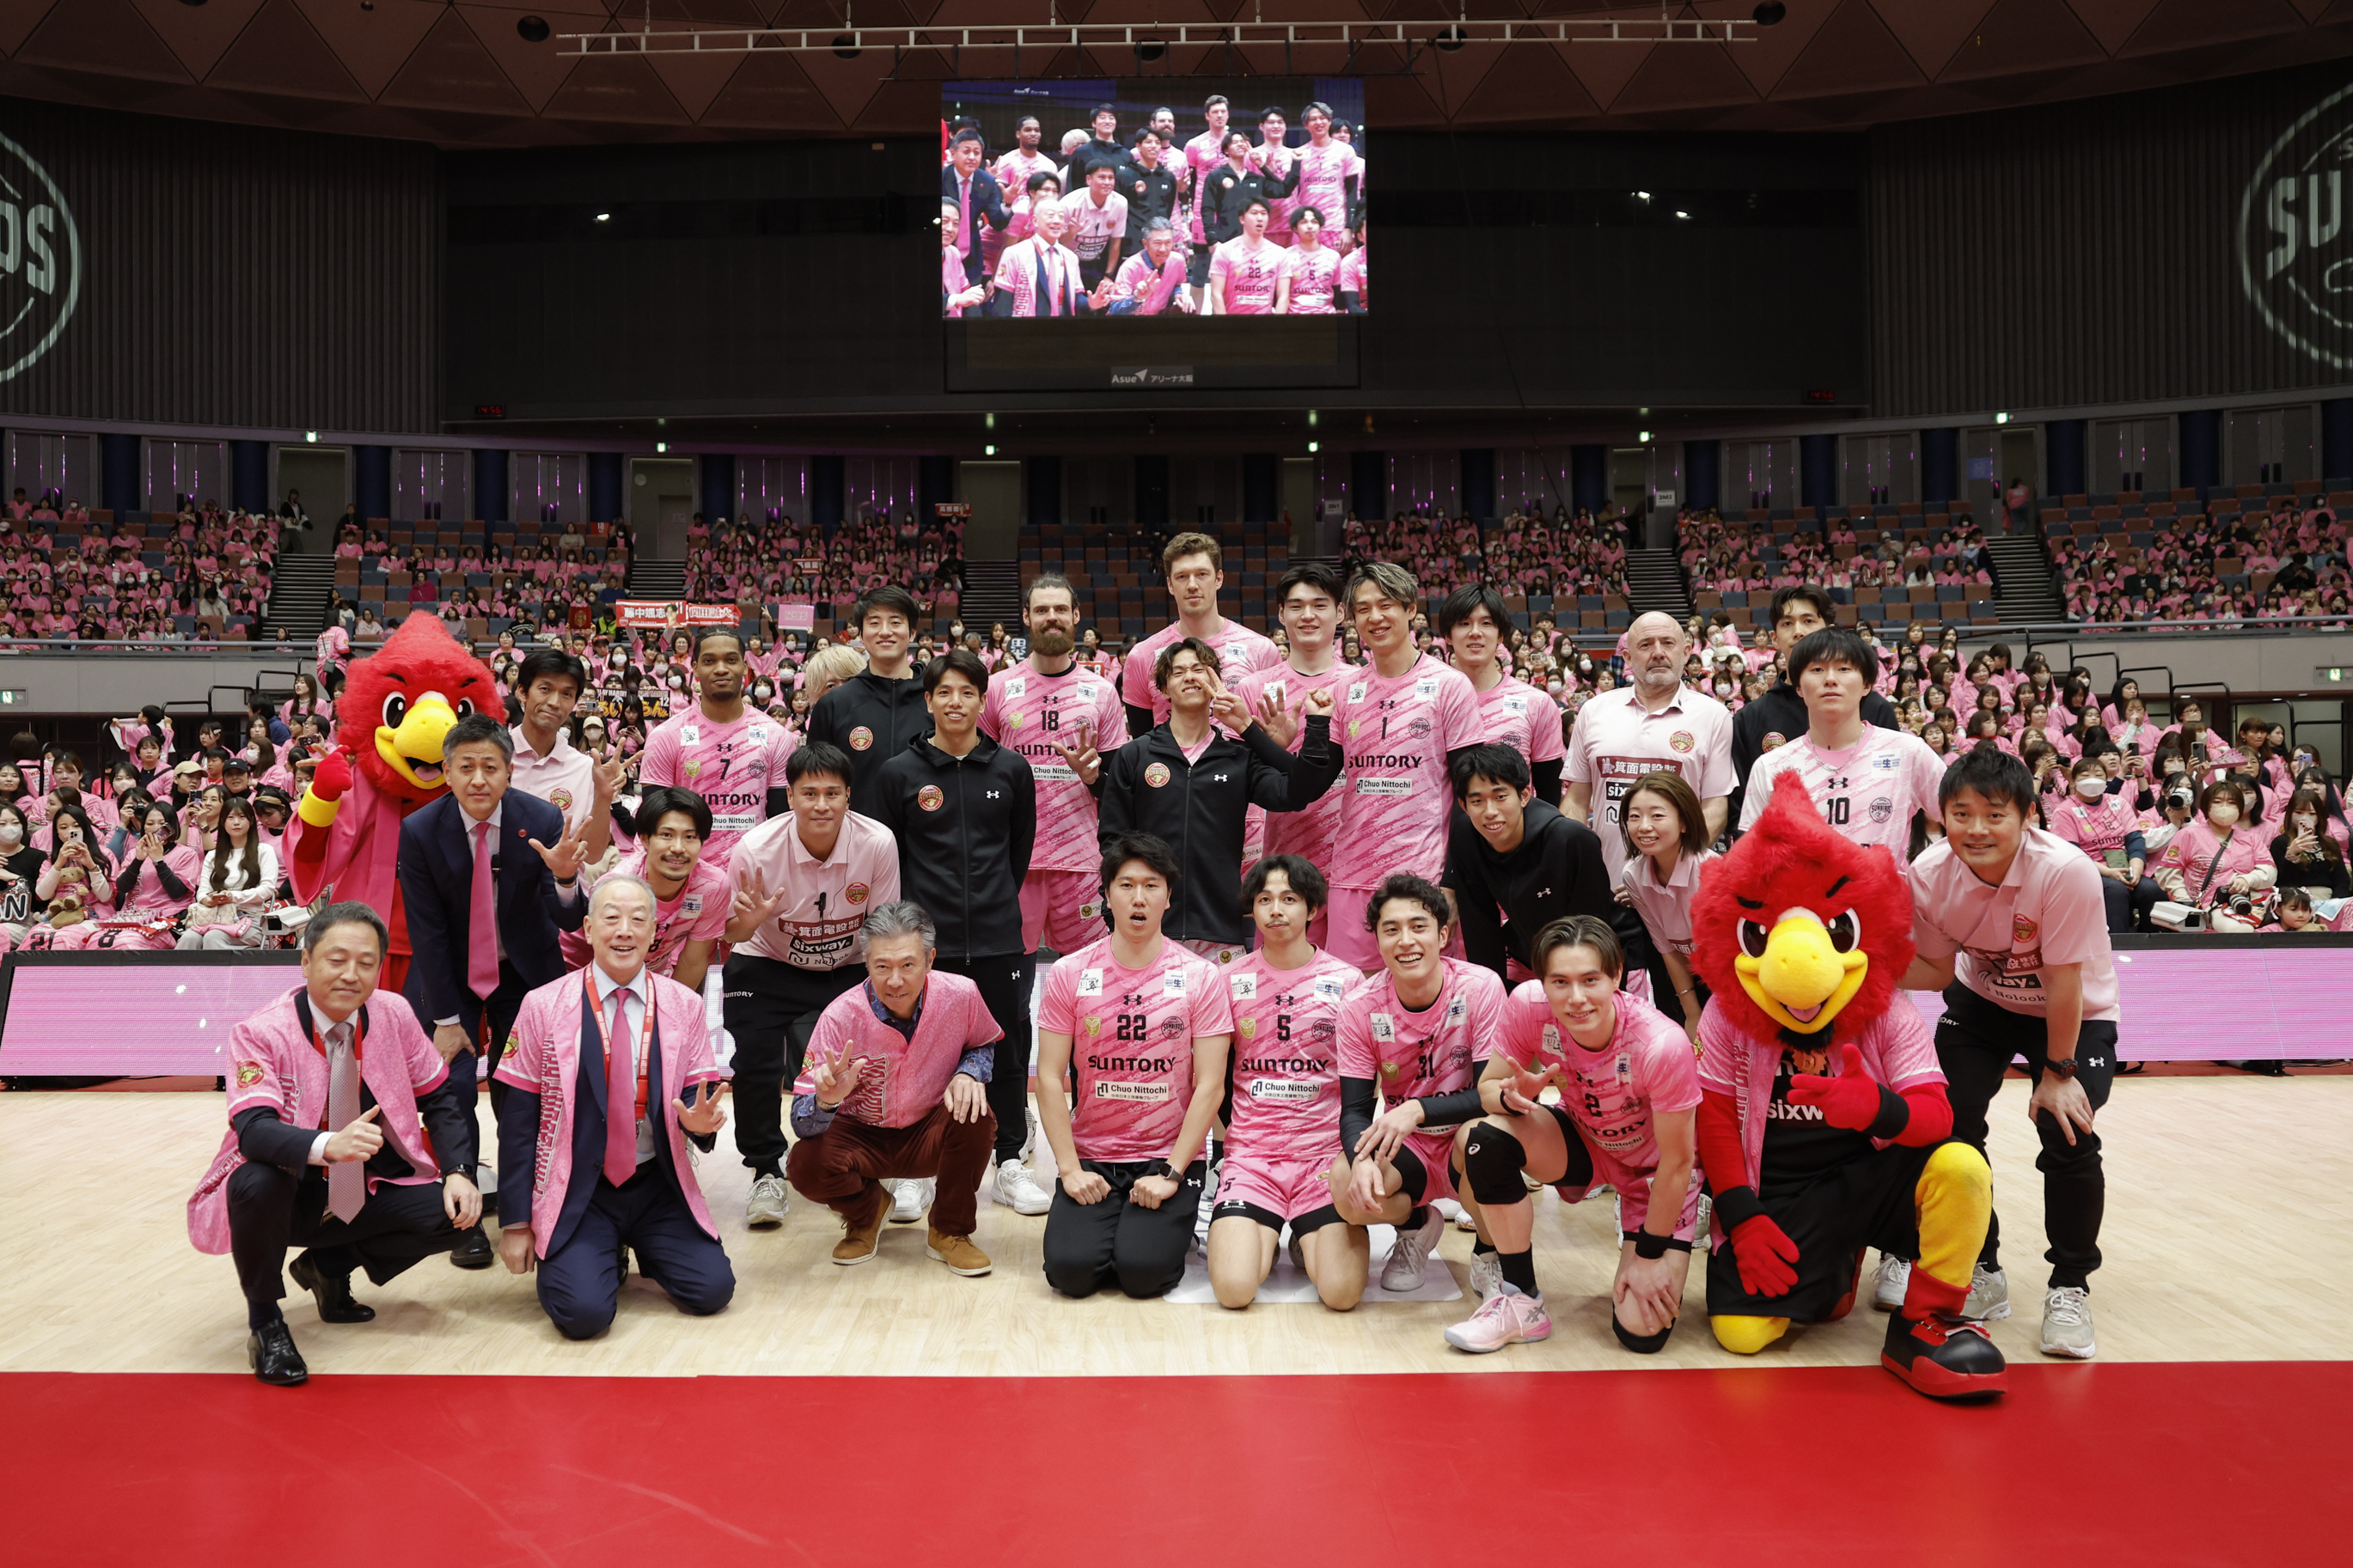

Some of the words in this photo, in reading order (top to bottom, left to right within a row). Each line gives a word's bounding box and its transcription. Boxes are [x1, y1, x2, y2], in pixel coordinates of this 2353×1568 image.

[1248, 266, 1262, 278] 22
[1309, 270, 1316, 280] 5
[1111, 375, 1137, 383] Asue
[659, 697, 669, 706] 12
[1041, 711, 1059, 731] 18
[1381, 717, 1388, 740] 1
[1348, 754, 1422, 768] SUNTORY
[1882, 759, 1892, 768] 生
[719, 759, 730, 780] 7
[1381, 780, 1411, 789] Nittochi
[1827, 797, 1850, 825] 10
[1871, 804, 1892, 813] SUNBIRDS
[30, 930, 56, 951] 21
[1173, 979, 1182, 988] 生
[1324, 984, 1332, 994] 生
[1117, 1014, 1146, 1040] 22
[1277, 1015, 1291, 1041] 5
[1087, 1055, 1176, 1073] SUNTORY
[1240, 1058, 1330, 1072] SUNTORY
[1110, 1084, 1132, 1093] Chuo
[1134, 1085, 1167, 1095] Nittochi
[1264, 1083, 1286, 1091] Chuo
[1287, 1084, 1320, 1093] Nittochi
[1585, 1092, 1603, 1118] 2
[1604, 1136, 1642, 1149] Nittochi
[1222, 1177, 1236, 1193] 5
